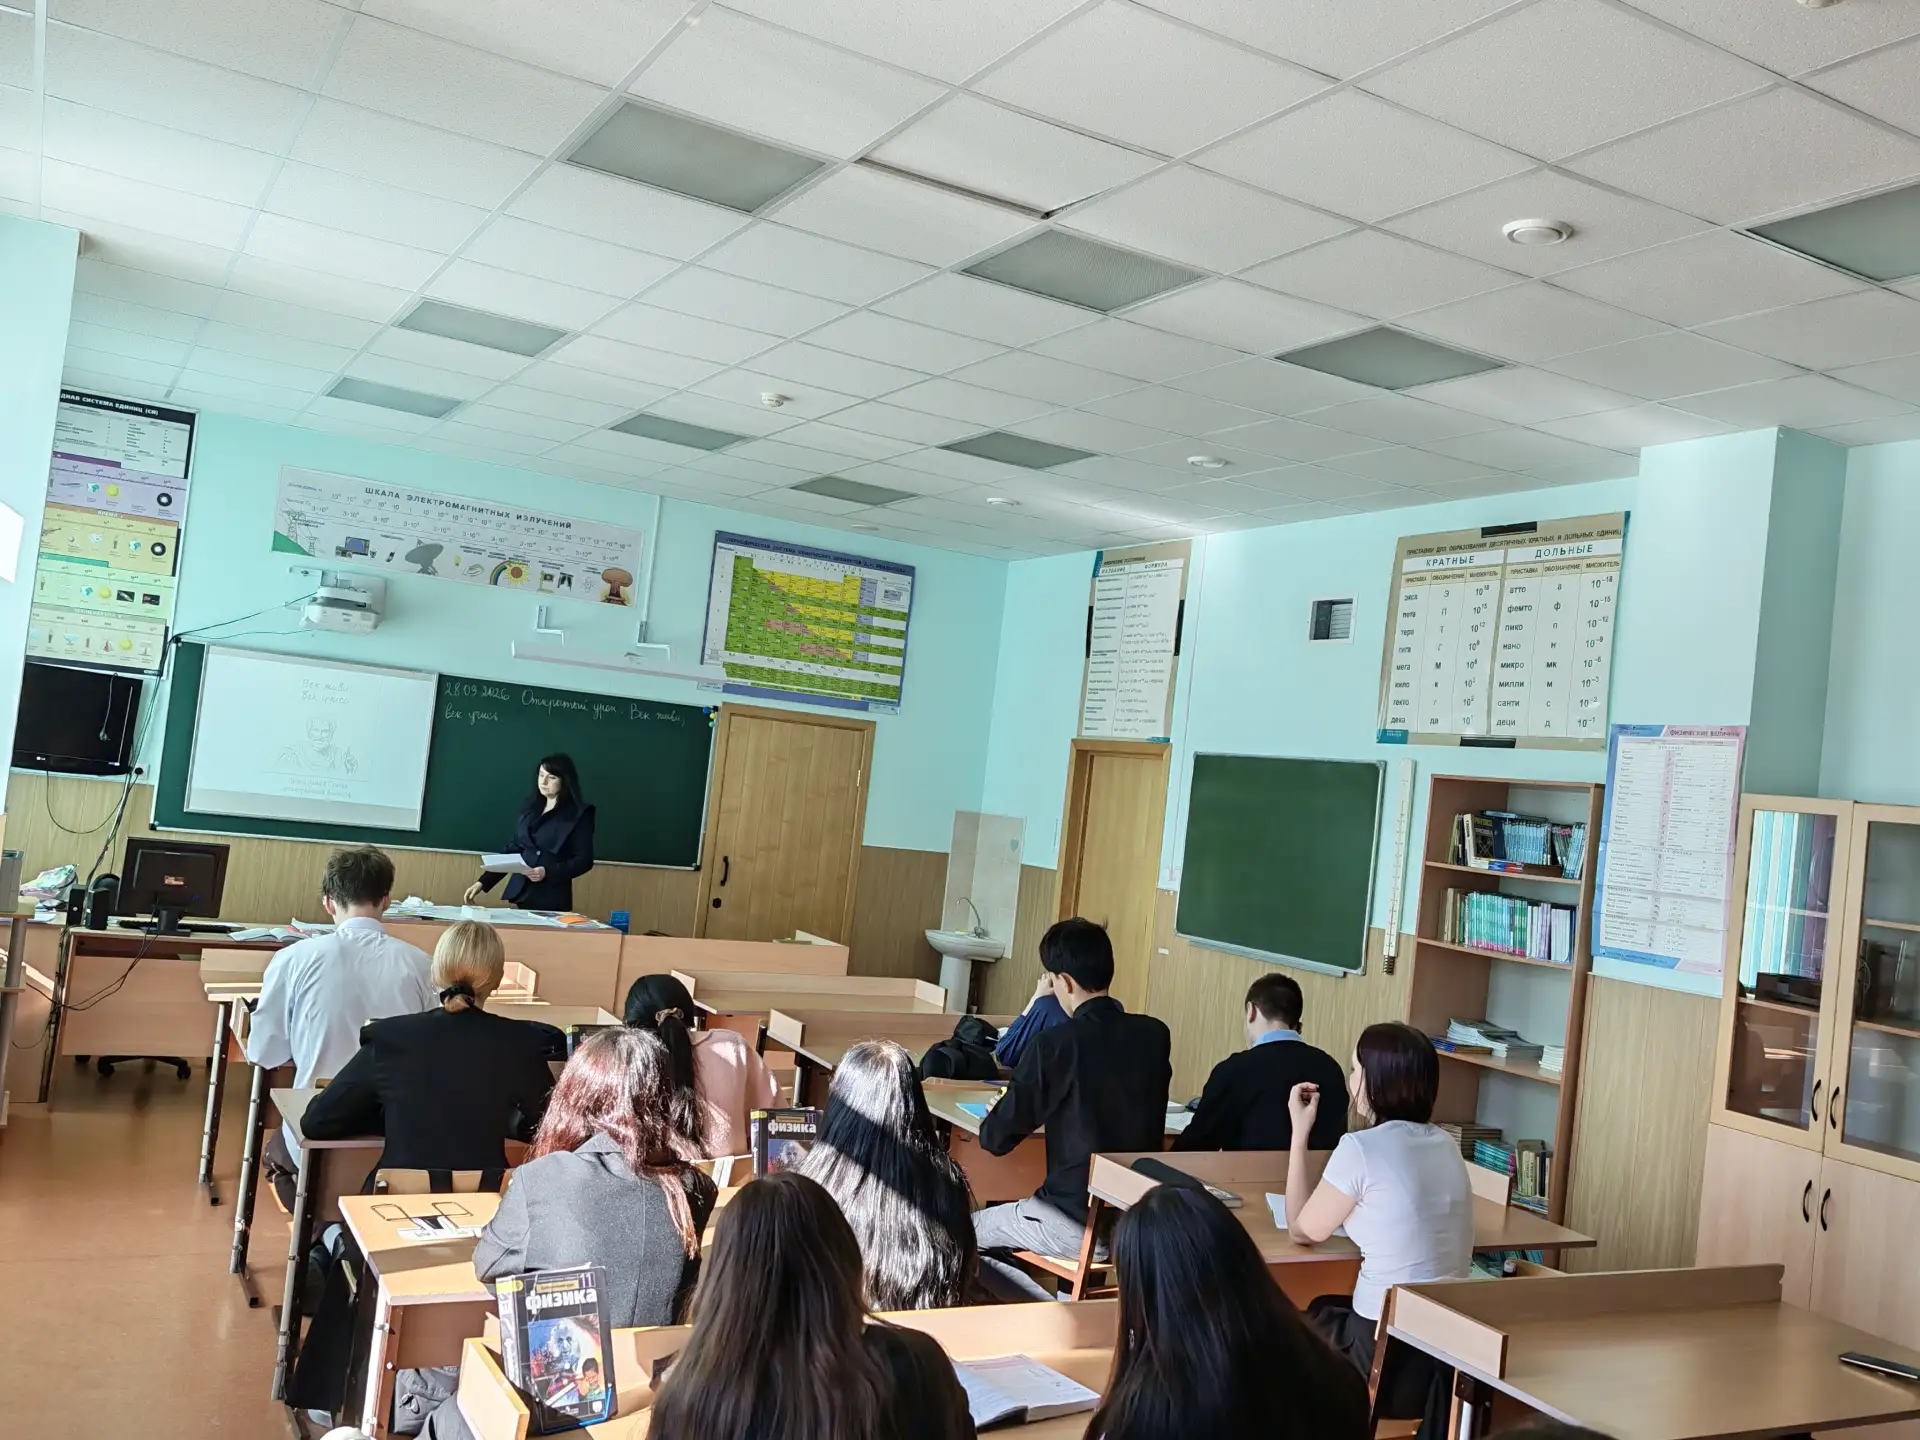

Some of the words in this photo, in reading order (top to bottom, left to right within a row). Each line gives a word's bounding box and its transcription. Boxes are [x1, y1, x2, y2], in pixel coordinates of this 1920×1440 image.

[82, 397, 113, 407] СИСТЕМА
[115, 403, 143, 413] ЕДИНИЦ
[365, 487, 400, 499] ШКАЛА
[407, 494, 511, 519] ЭЛЕКТРОМАГНИТНЫХ
[516, 514, 572, 529] ИЗЛУЧЕНИЙ
[1436, 546, 1447, 554] ДЛЯ
[1449, 542, 1487, 552] ОБРАЗОВАНИЯ
[1488, 538, 1526, 549] ДЕСЯТИЧНЫХ
[1529, 536, 1554, 544] КРАТНЫХ
[1564, 532, 1594, 541] ДОЛЬНЫХ
[1596, 529, 1622, 537] ЕДИНИЦ
[1534, 544, 1594, 559] ДОЛЬНЫЕ
[1426, 555, 1475, 567] КРАТНЫЕ
[1510, 567, 1539, 575] ПРИСТАВКА
[1544, 563, 1581, 572] ОБОЗНАЧЕНИЕ
[1585, 561, 1620, 569] МНОЖИТЕЛЬ
[1509, 586, 1526, 594] атто
[1507, 604, 1533, 614] фемто
[1396, 663, 1411, 671] мега
[1500, 662, 1525, 670] микро
[468, 710, 499, 726] учись
[630, 702, 651, 720] Век
[1390, 716, 1406, 724] дека
[1496, 719, 1516, 727] деци
[1669, 729, 1709, 737] ФИЗИЧЕСКИЕ
[805, 1113, 815, 1123] 11
[768, 1119, 817, 1135] физика
[579, 1272, 595, 1288] 11
[525, 1288, 598, 1315] физика
